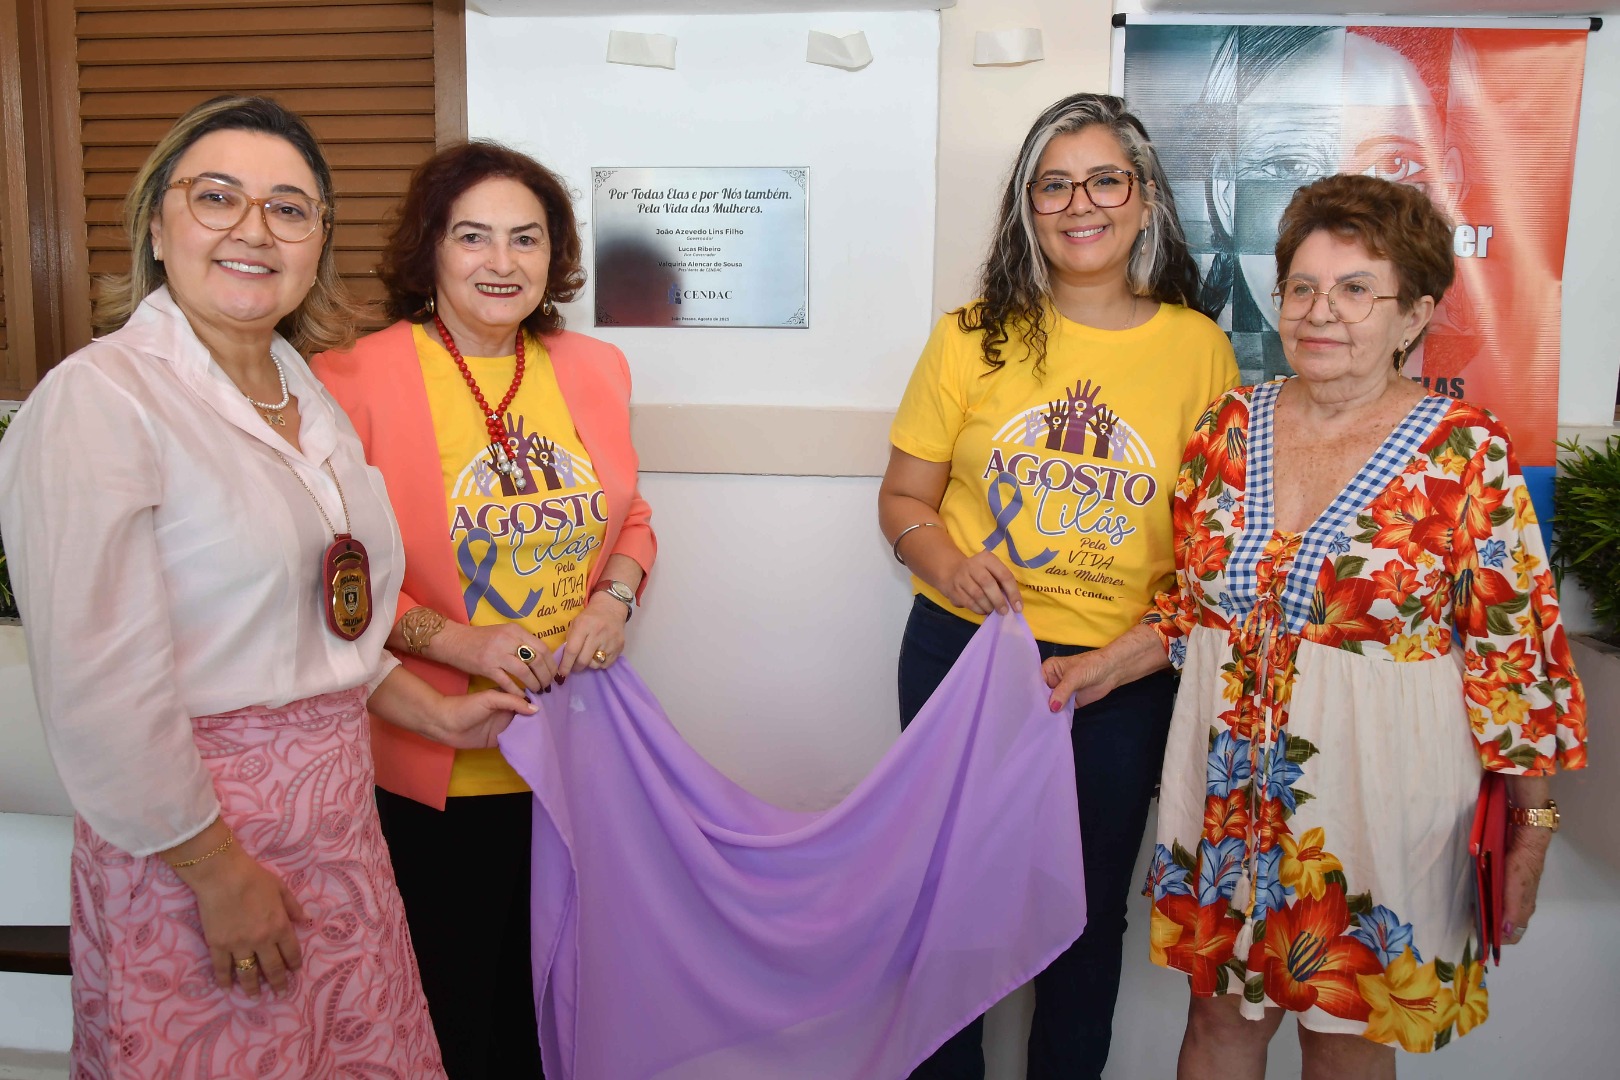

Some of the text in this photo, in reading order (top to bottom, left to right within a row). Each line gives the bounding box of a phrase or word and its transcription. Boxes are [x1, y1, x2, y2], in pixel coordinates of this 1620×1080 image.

[609, 187, 792, 202] Por Todas Elas e por Nós também.
[637, 203, 763, 214] Pela Vida das Mulheres.
[1449, 224, 1493, 258] er
[683, 290, 733, 300] CENDAC
[982, 448, 1157, 507] AGOSTO
[1033, 477, 1137, 547] Lilás
[509, 519, 600, 577] Lilás
[1080, 537, 1108, 551] Pela
[1068, 550, 1114, 570] VIDA
[554, 561, 576, 576] Pela
[1045, 565, 1126, 587] das Mulheres
[552, 573, 584, 597] VIDA
[1026, 583, 1072, 596] mpanha
[537, 605, 557, 618] das
[532, 625, 566, 640] panha
